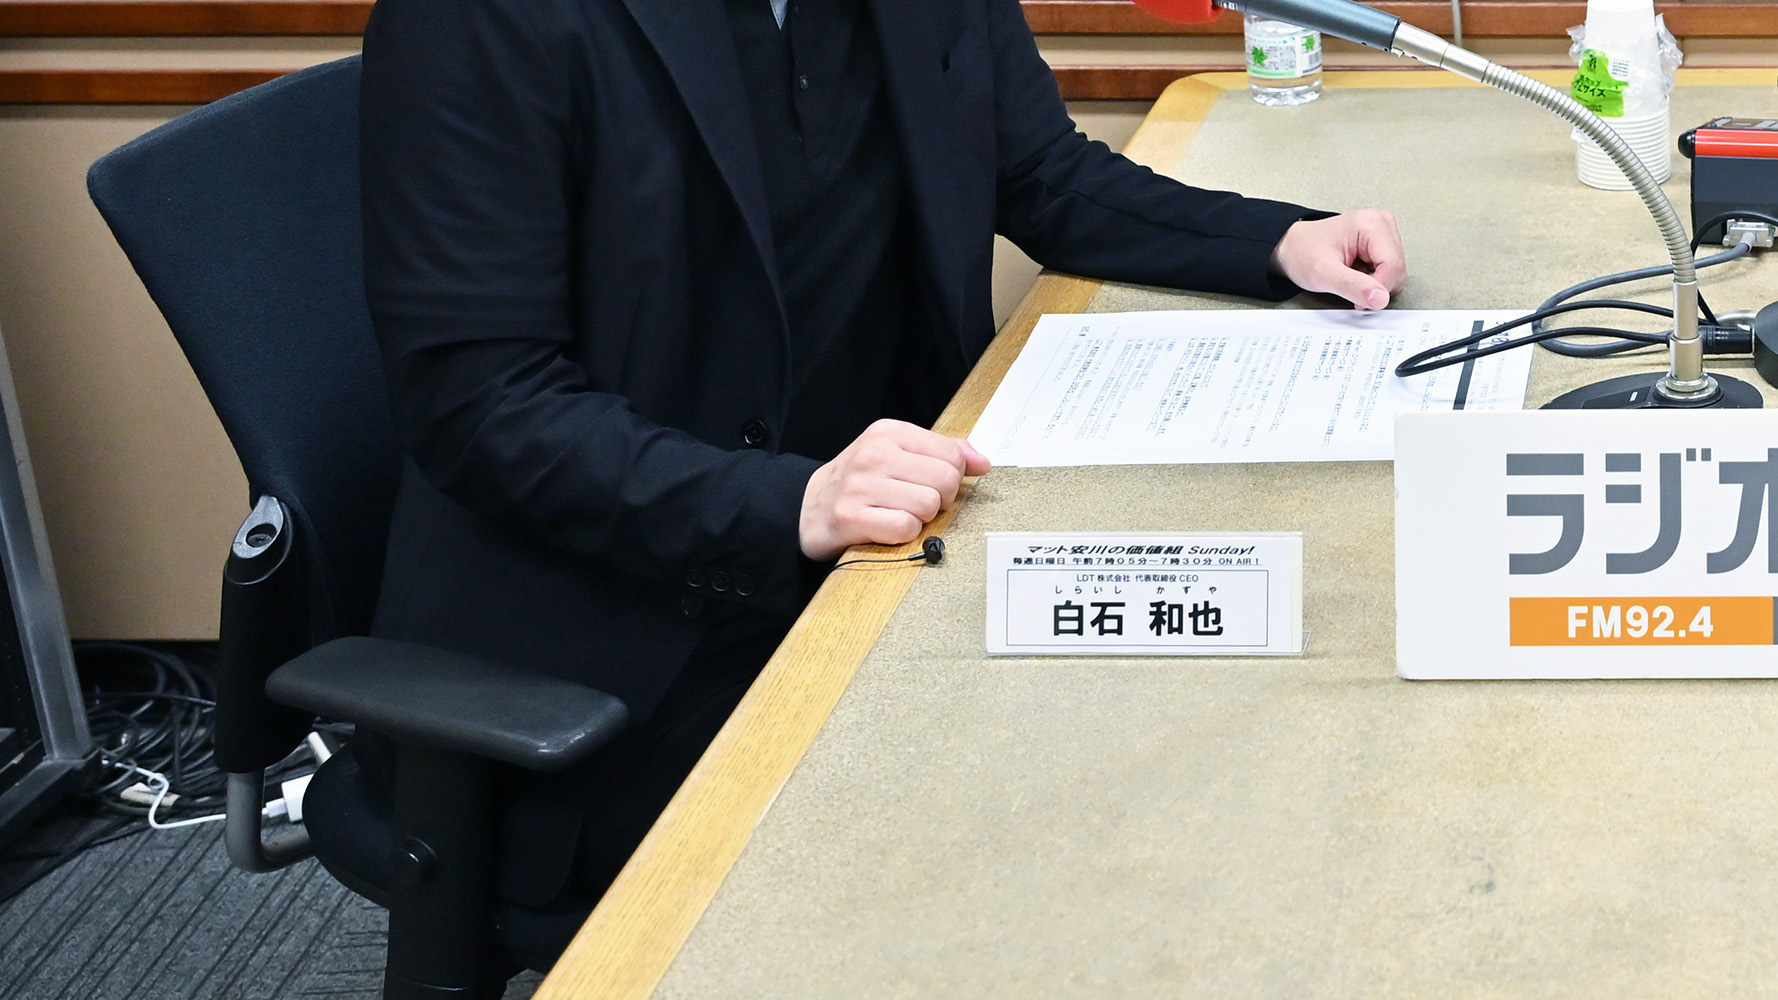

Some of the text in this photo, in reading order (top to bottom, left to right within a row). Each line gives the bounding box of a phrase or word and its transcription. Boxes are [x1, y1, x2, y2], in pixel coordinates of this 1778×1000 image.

[1028, 545, 1255, 555] マット安川の価値組 Sunday!
[1013, 557, 1065, 565] 毎週日曜日
[1218, 557, 1233, 565] ON
[1076, 574, 1199, 583] LDT 株式会社 代表取締役 CEO
[1055, 585, 1217, 594] しらいし かずや
[1053, 600, 1224, 636] 白石 和也
[1567, 605, 1714, 638] FM92.4
